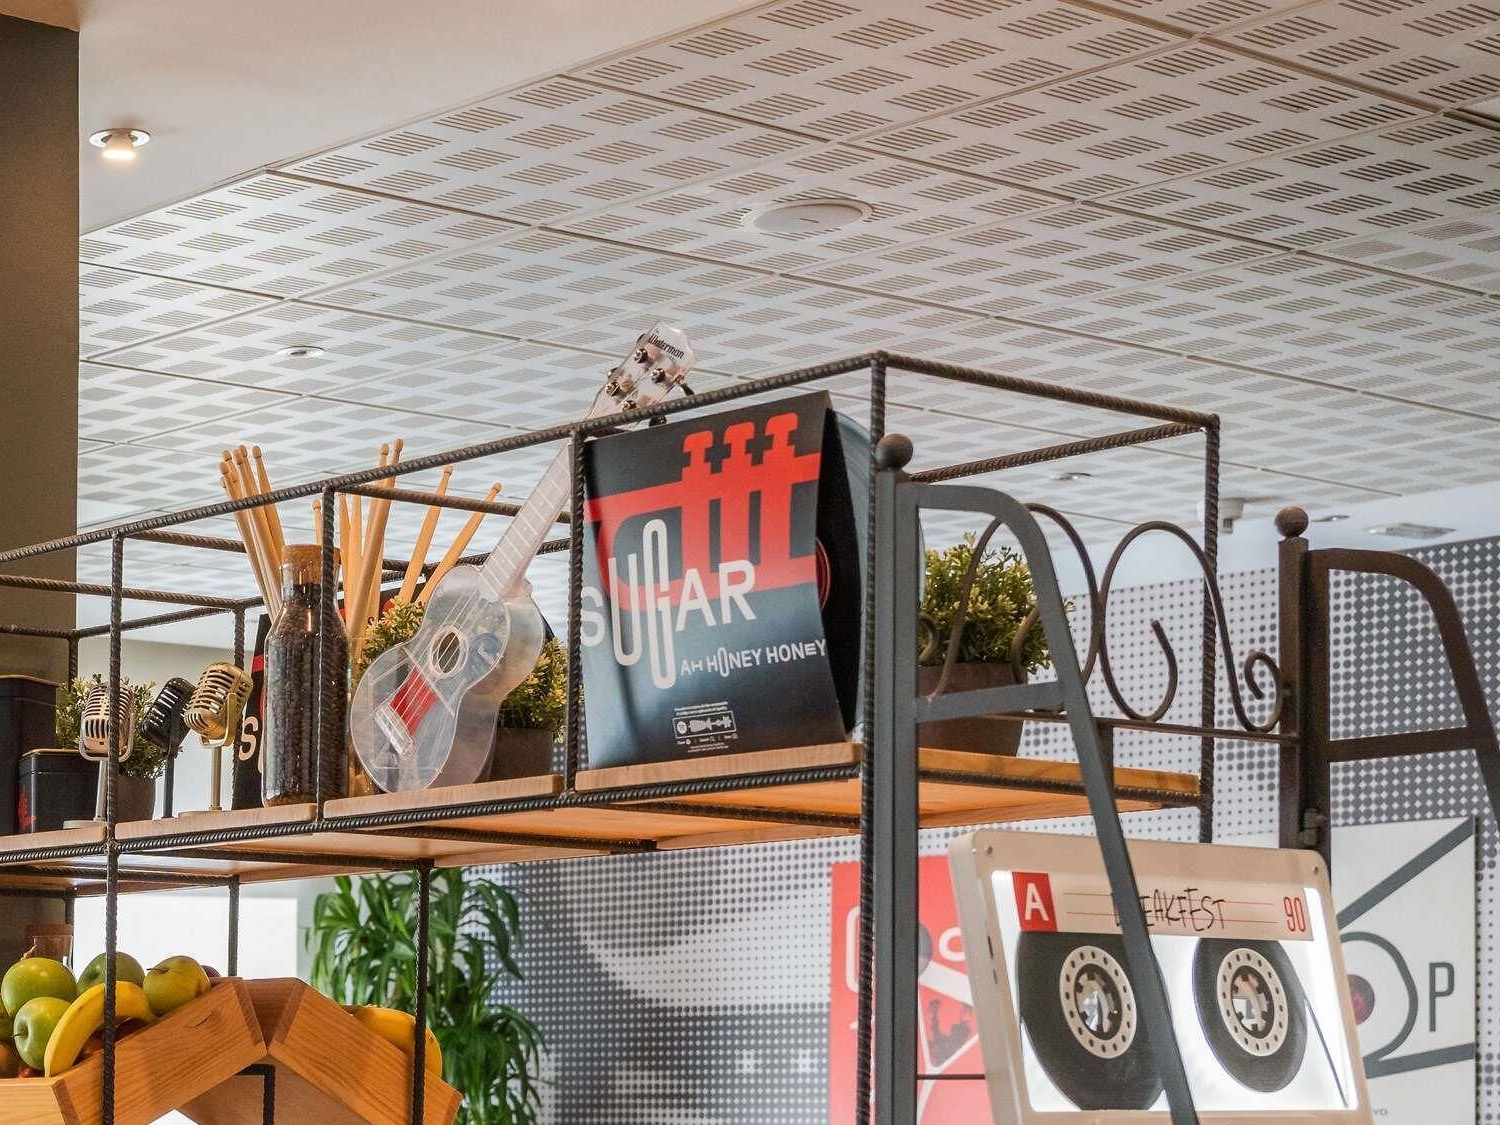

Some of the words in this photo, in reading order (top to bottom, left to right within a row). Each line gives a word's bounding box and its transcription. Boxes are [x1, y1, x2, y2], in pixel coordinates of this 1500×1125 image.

[580, 518, 757, 690] SUGAR
[680, 658, 703, 677] AH
[706, 646, 763, 678] HONEY
[765, 638, 827, 664] HONEY
[1023, 882, 1050, 922] A
[1111, 887, 1227, 932] EAKFEST
[1283, 895, 1307, 932] 90
